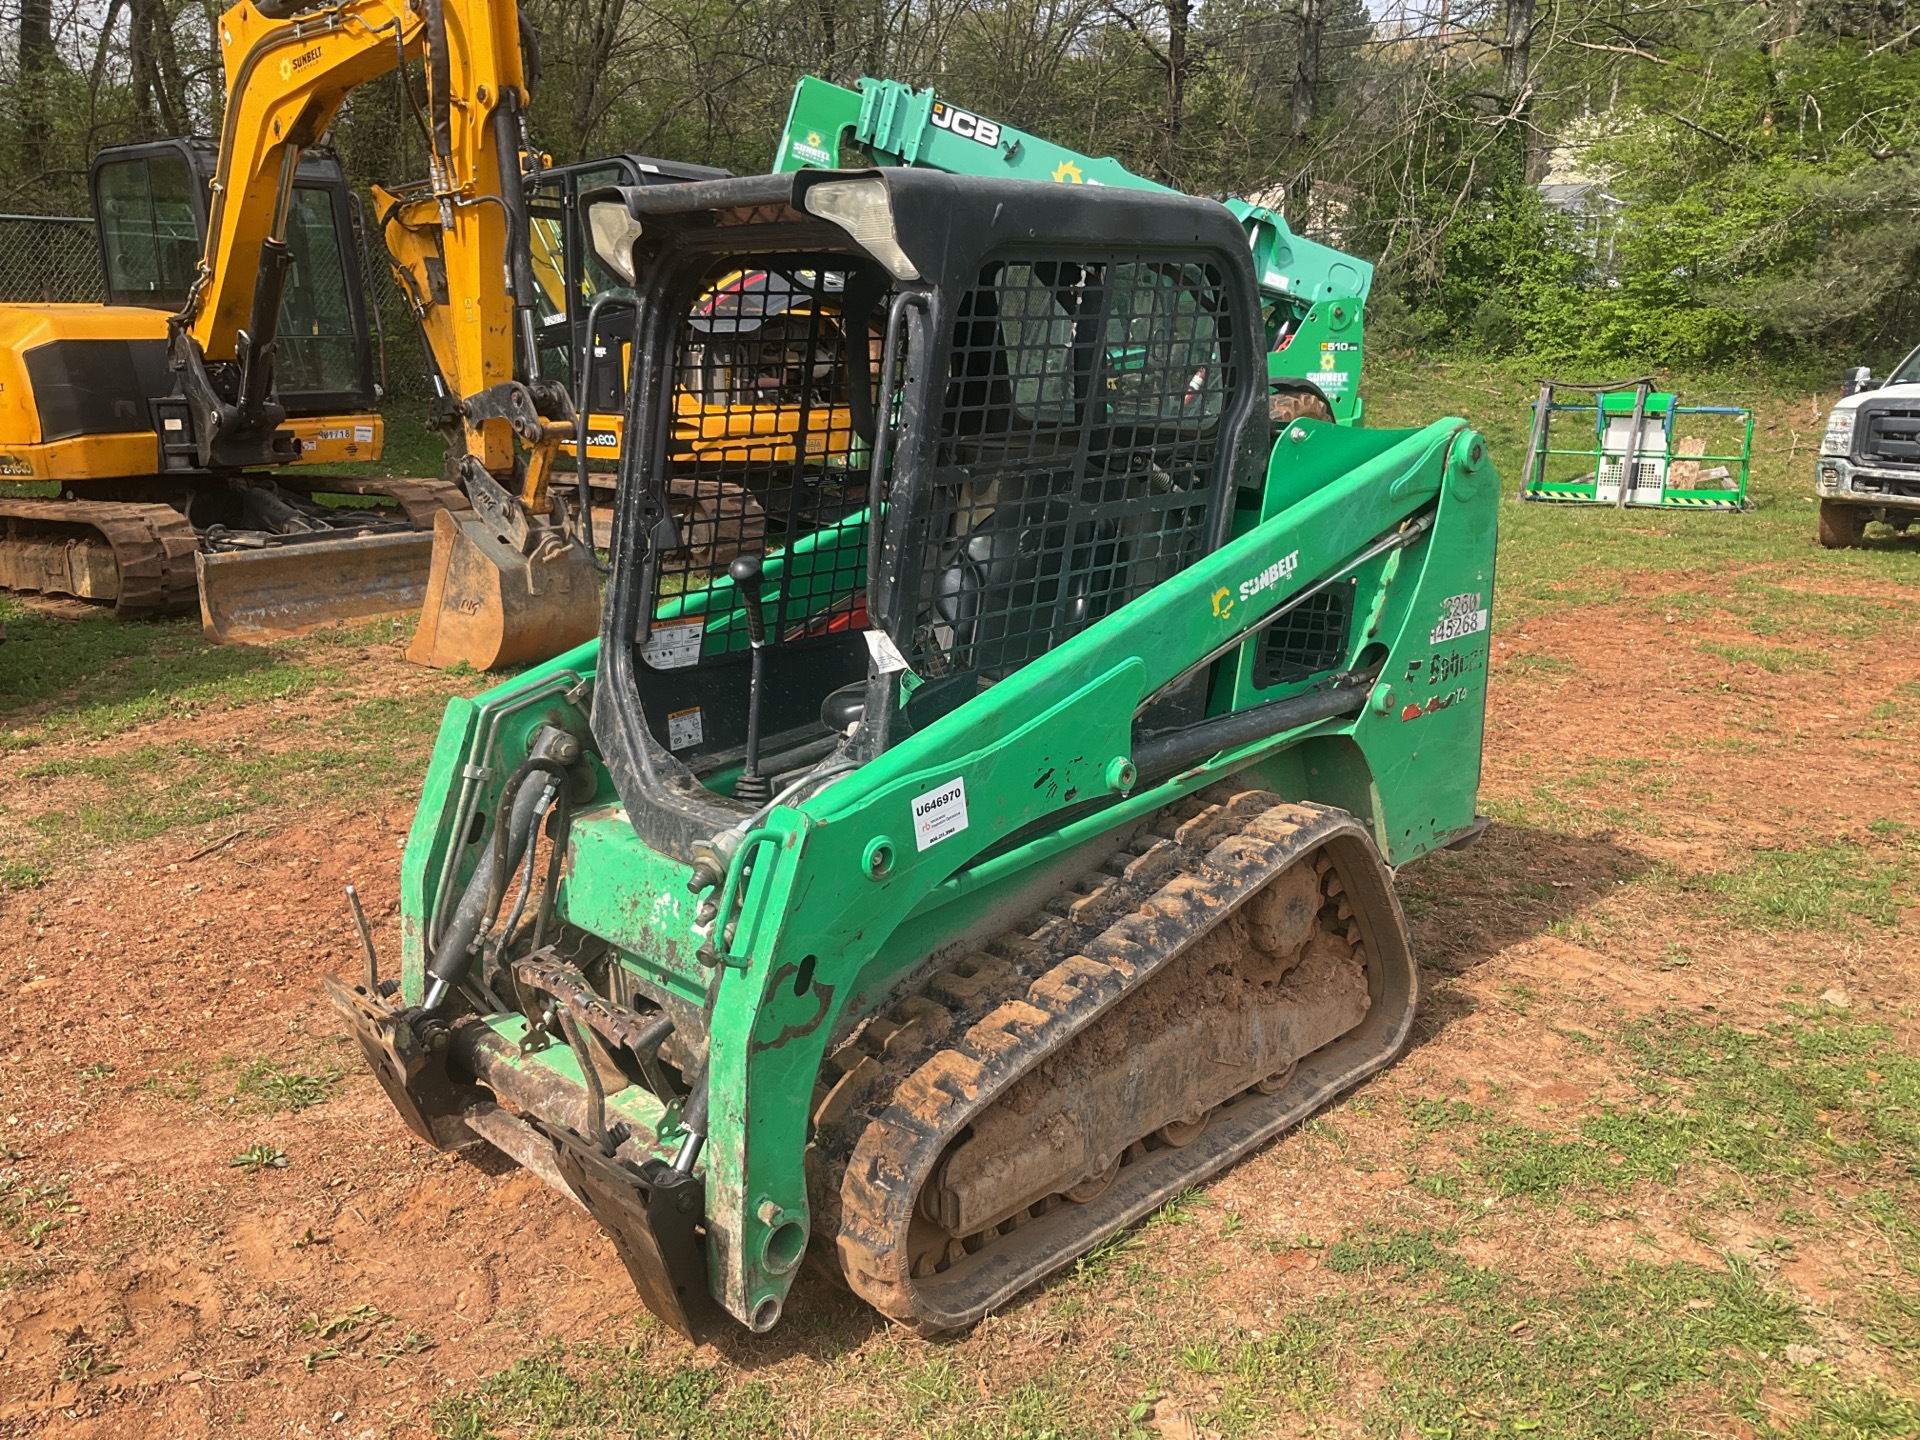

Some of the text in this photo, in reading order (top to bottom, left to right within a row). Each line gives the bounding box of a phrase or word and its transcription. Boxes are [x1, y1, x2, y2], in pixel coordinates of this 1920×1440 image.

[292, 45, 322, 70] SUNBELT
[931, 103, 1000, 146] JCB
[793, 141, 830, 161] SUNBELT
[1306, 372, 1349, 382] SUNBELT
[1239, 549, 1299, 601] SUNBELT
[915, 787, 961, 817] U646970
